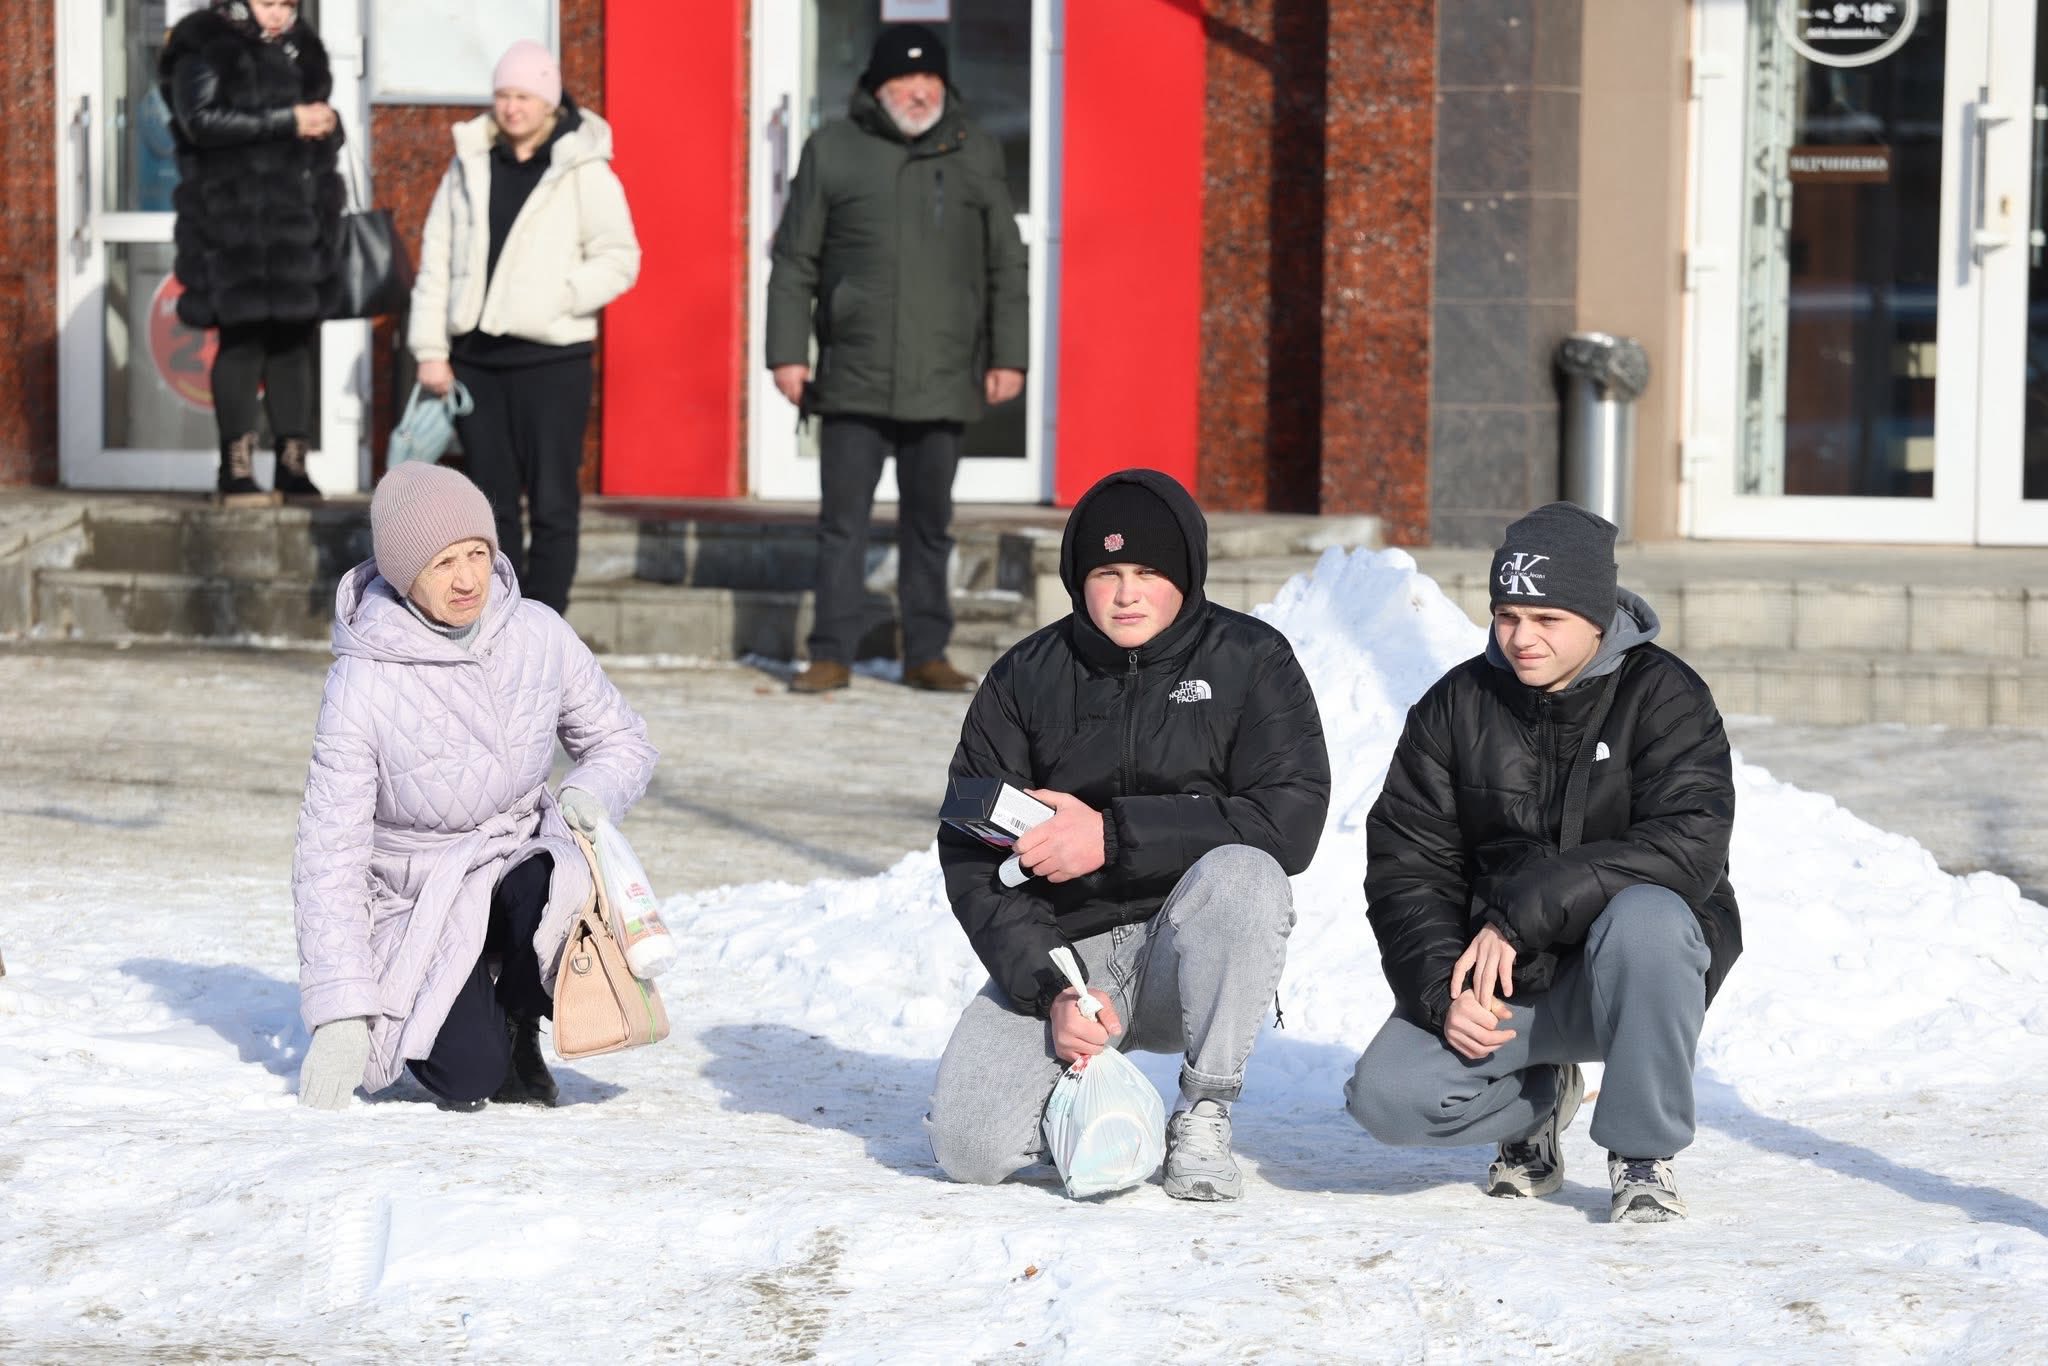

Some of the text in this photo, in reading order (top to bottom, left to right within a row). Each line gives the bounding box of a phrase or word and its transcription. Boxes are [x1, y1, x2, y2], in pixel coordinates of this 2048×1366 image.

[1179, 680, 1197, 689] THE
[1168, 686, 1199, 701] NORTH
[1176, 694, 1199, 704] FACE
